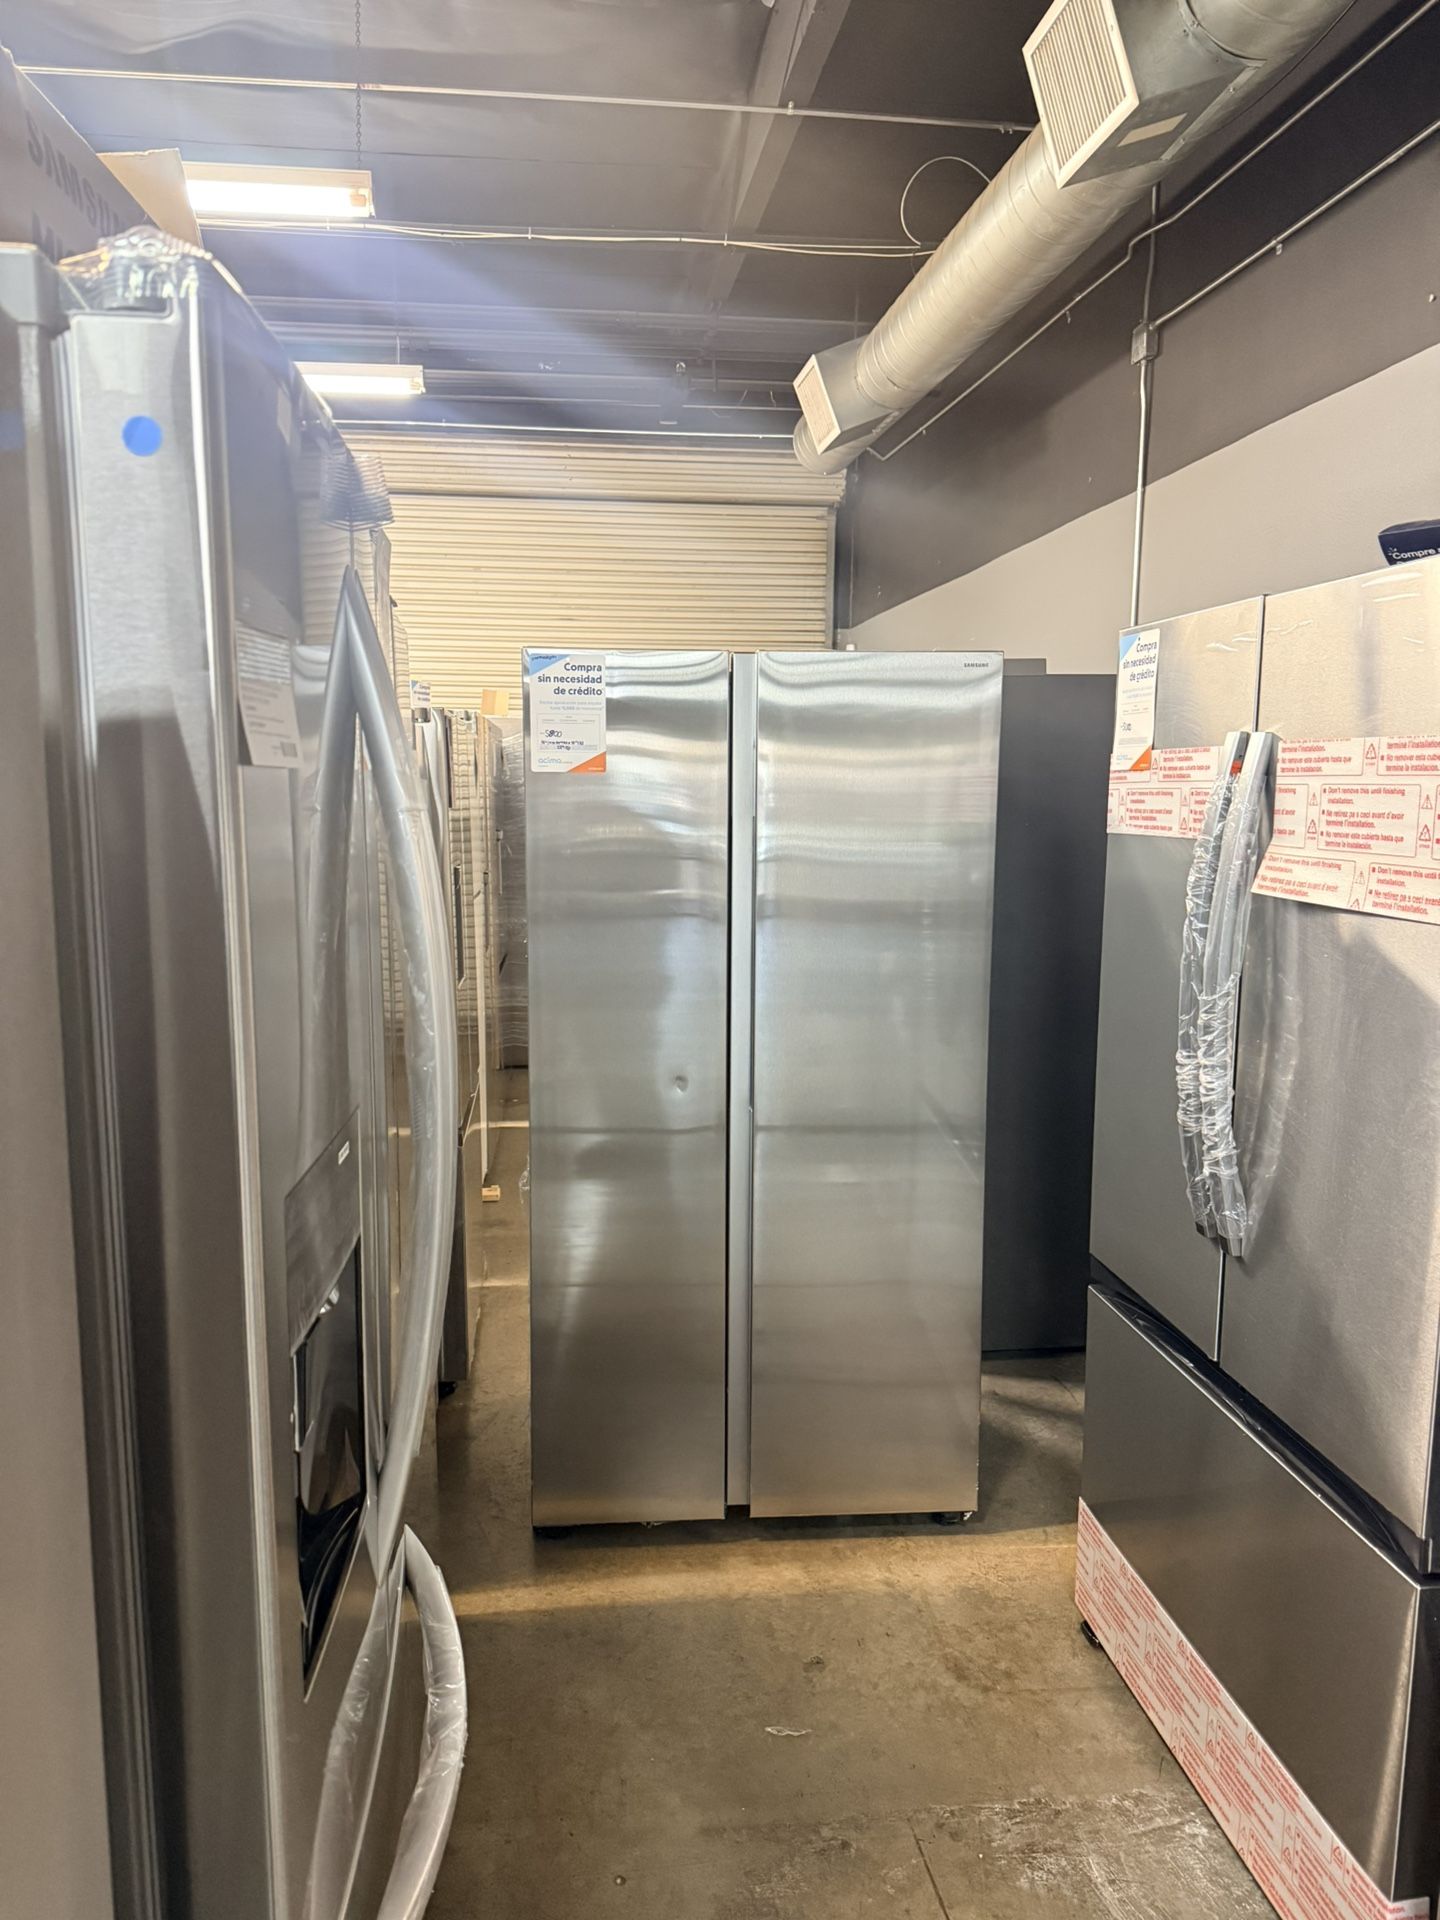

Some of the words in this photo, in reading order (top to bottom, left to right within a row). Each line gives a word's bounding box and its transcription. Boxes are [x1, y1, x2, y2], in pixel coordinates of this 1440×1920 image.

[1137, 642, 1157, 652] Compra
[1131, 654, 1156, 667] necesidad
[564, 663, 602, 672] Compra
[538, 674, 551, 682] sin
[554, 675, 602, 684] necesidad
[554, 686, 566, 694] de
[568, 686, 602, 696] crédito
[1378, 866, 1391, 874] Don't
